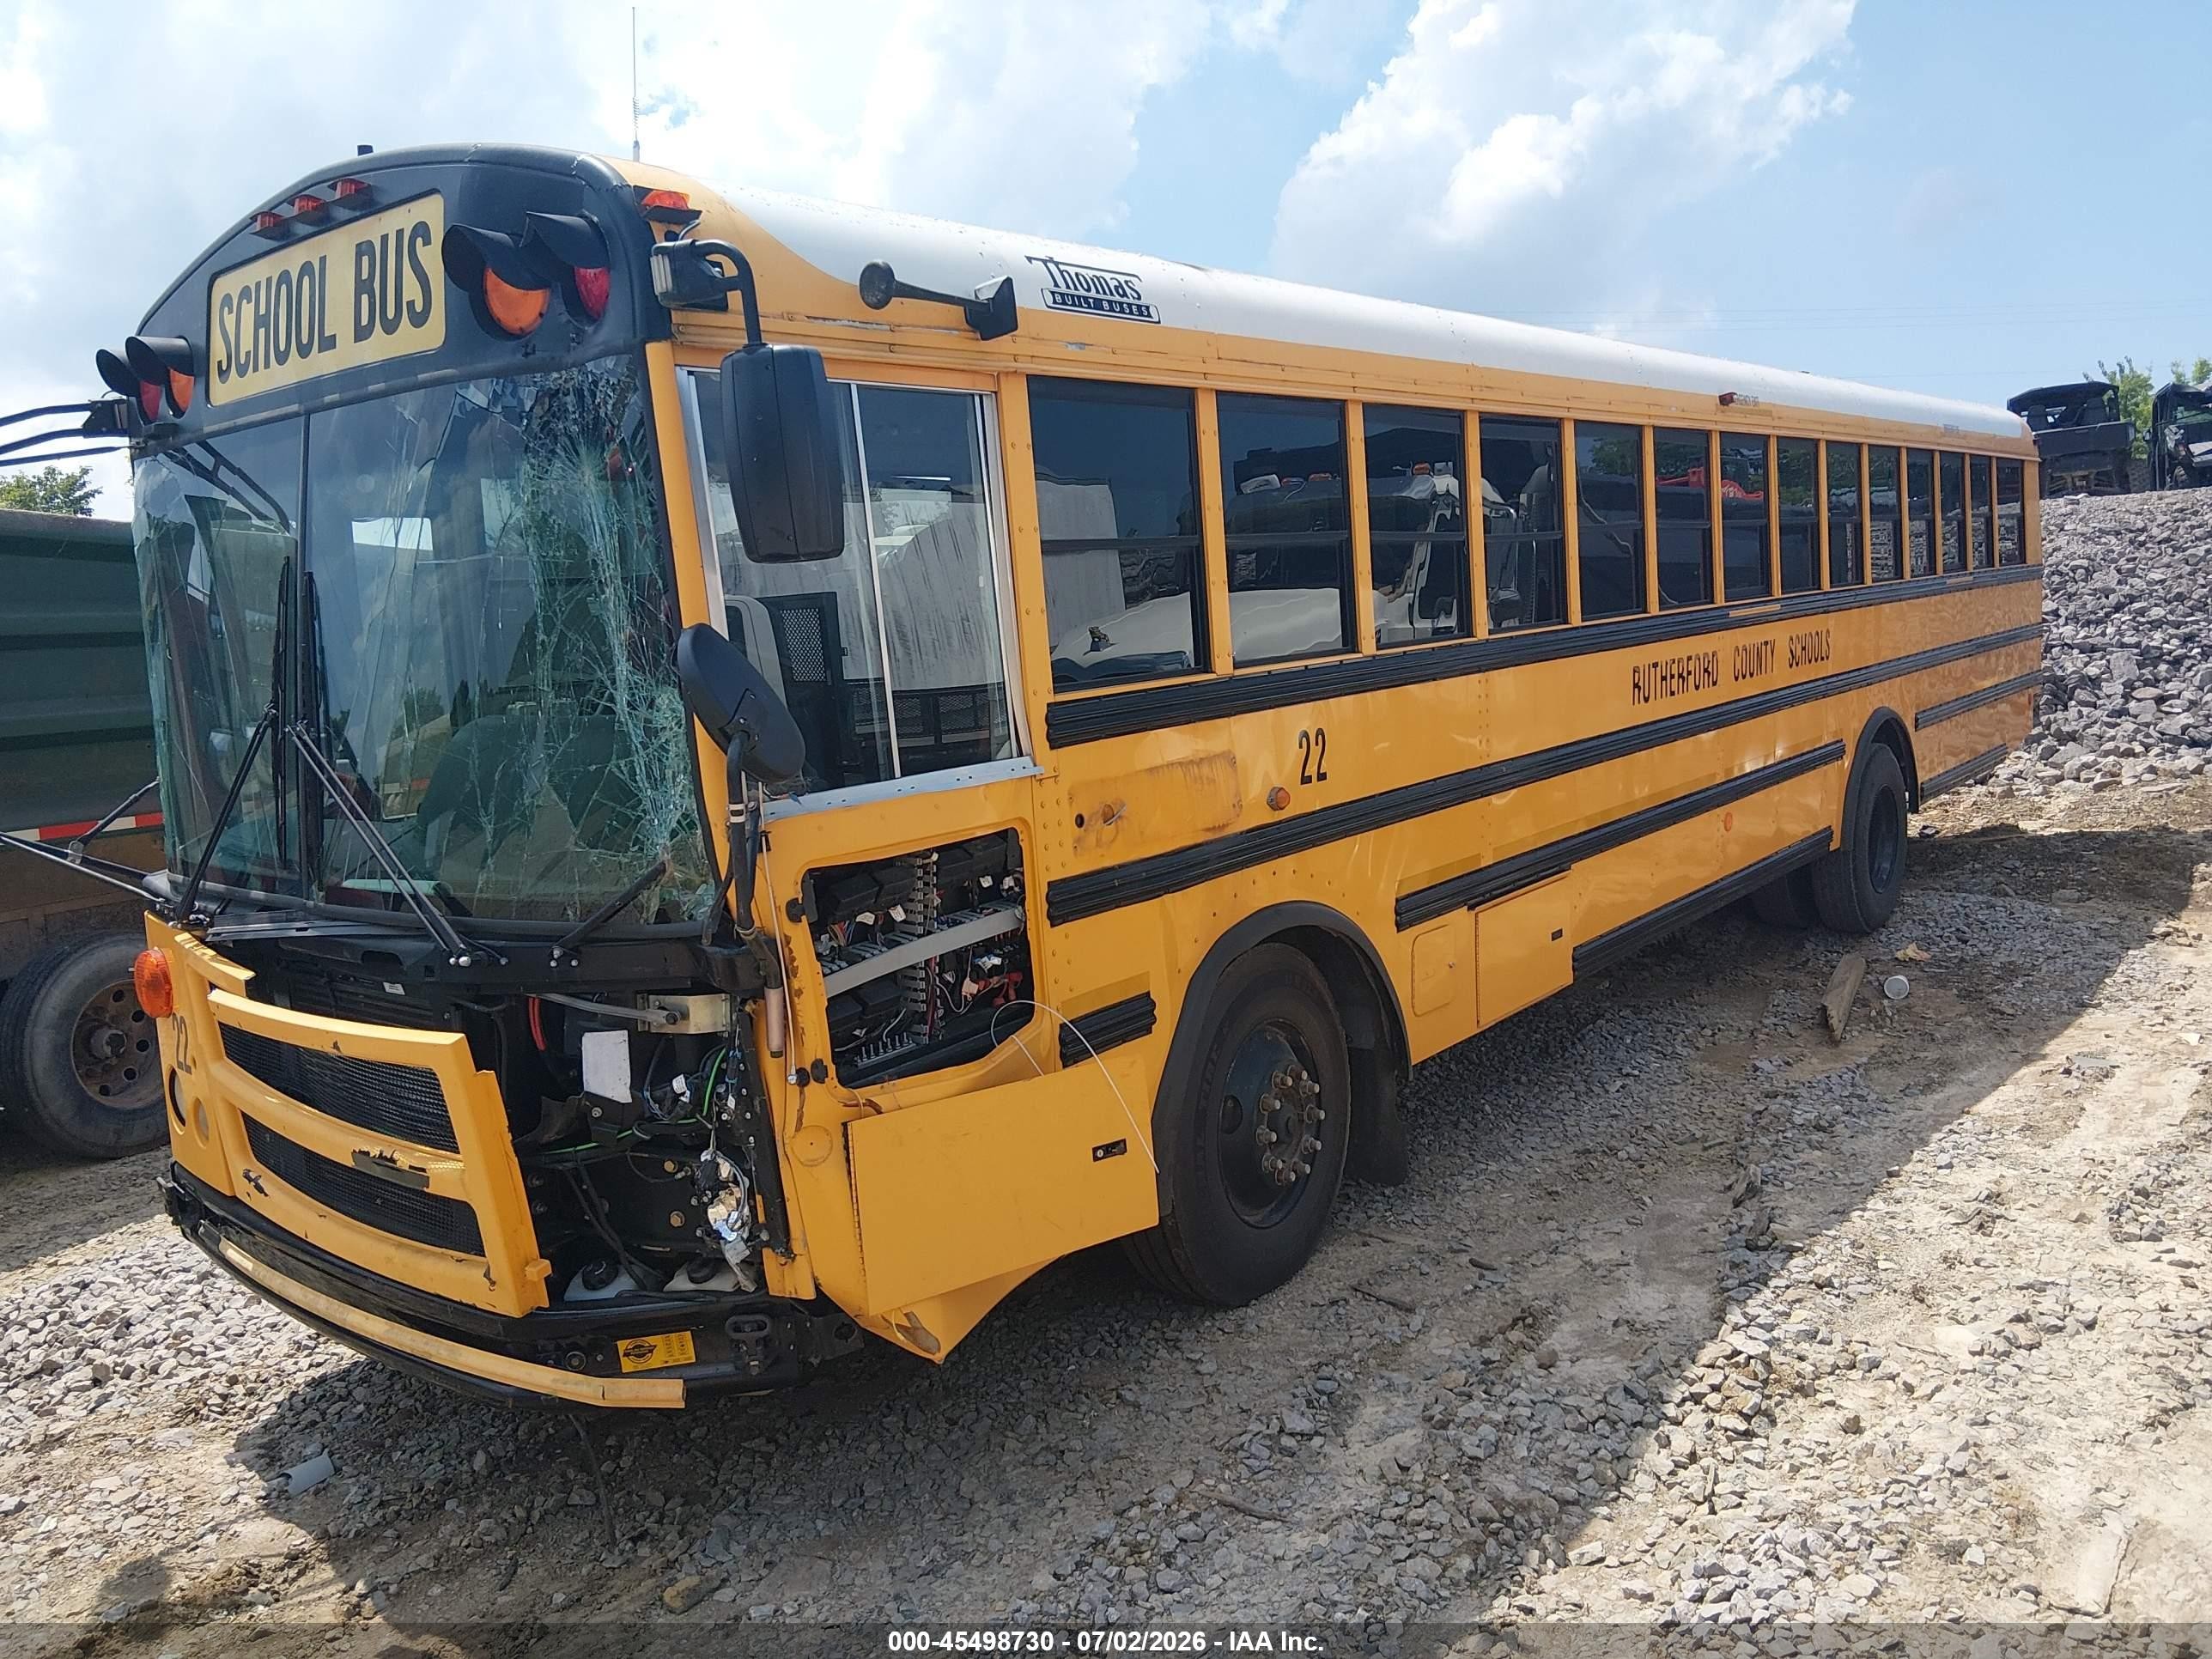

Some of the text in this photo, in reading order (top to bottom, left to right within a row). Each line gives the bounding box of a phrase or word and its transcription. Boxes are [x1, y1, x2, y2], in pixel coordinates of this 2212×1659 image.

[217, 221, 433, 384] SCHOOL BUS
[1024, 255, 1143, 301] Thomas
[1054, 293, 1149, 316] BUILT BUSES
[1632, 628, 1831, 706] RUTHERFORD COUNTY SCHOOLS
[1297, 727, 1328, 786] 22
[172, 1012, 192, 1076] 22
